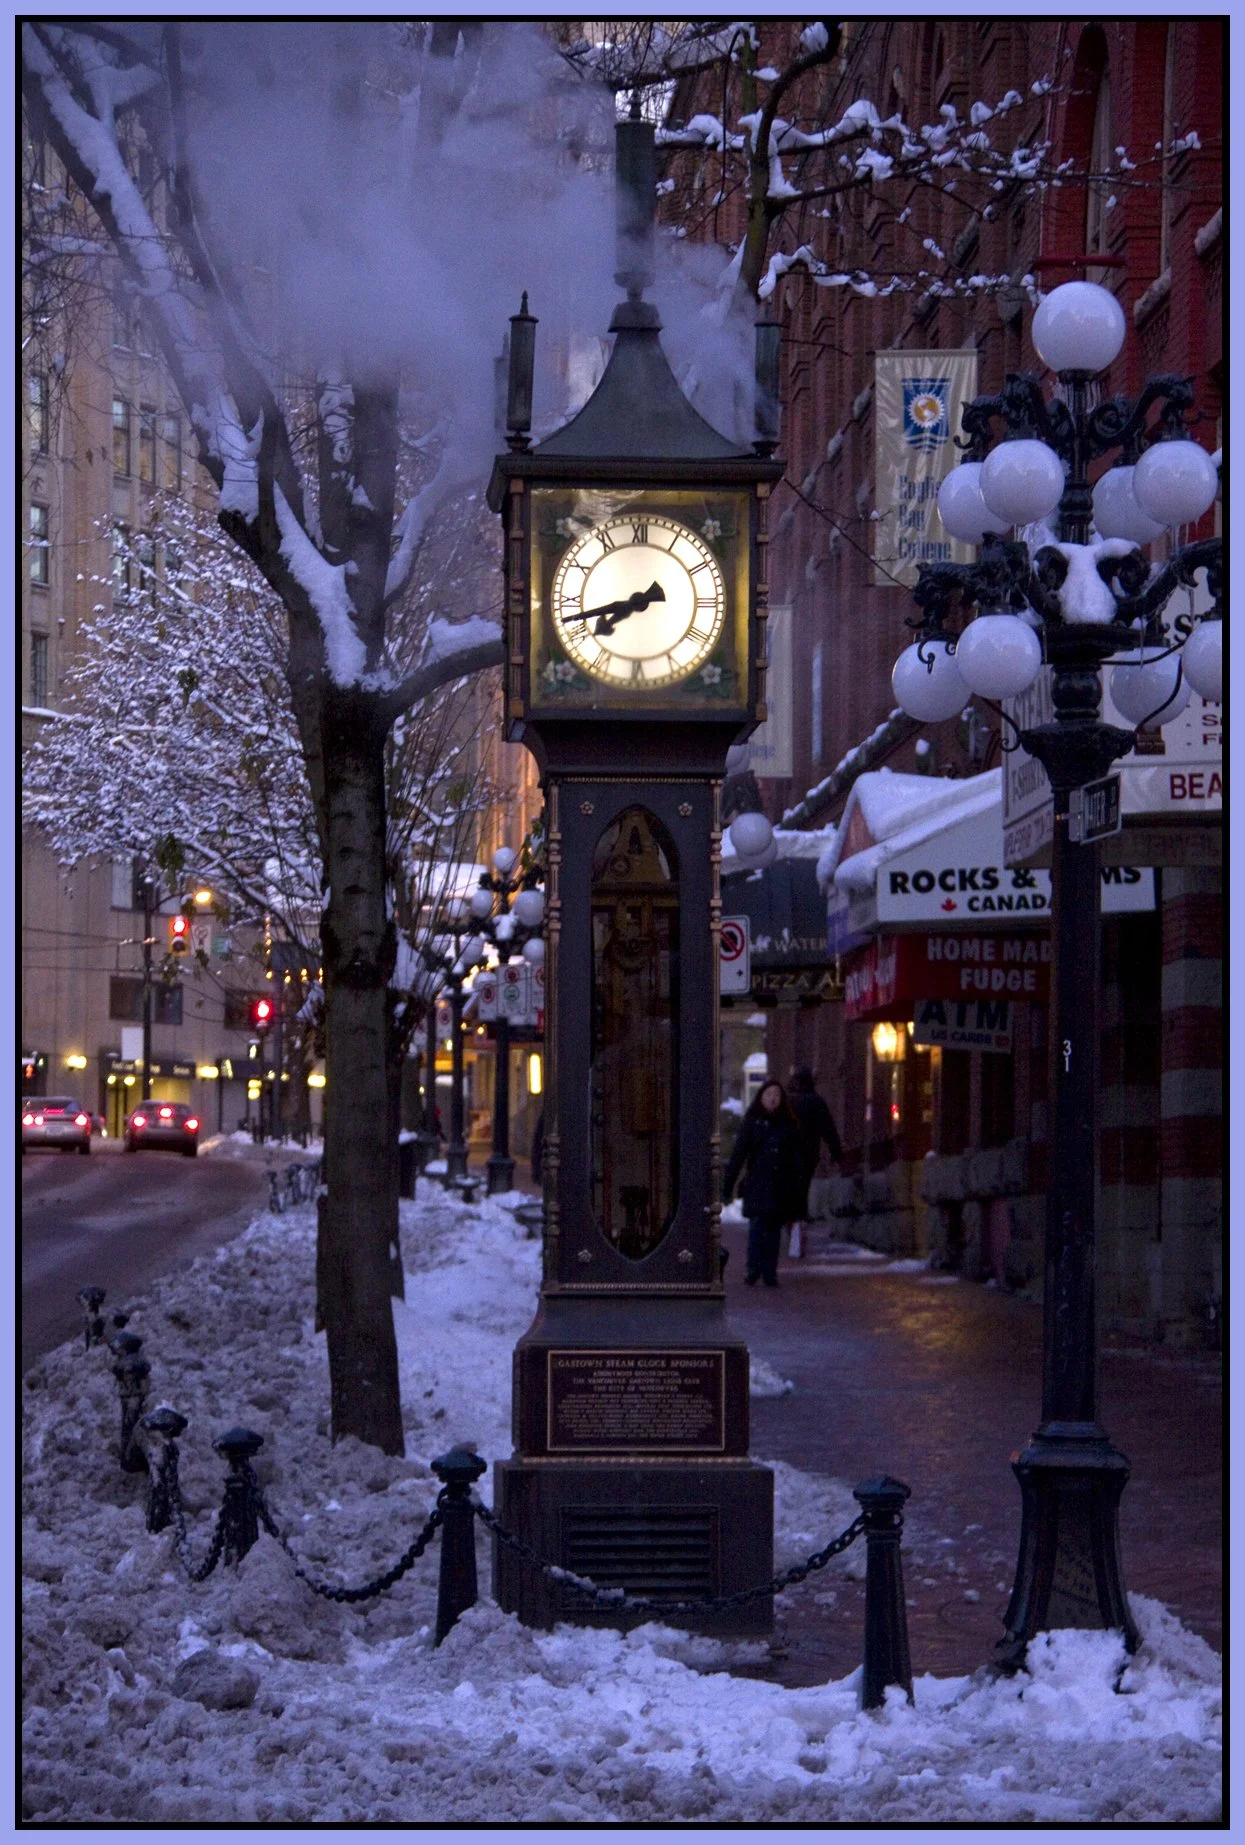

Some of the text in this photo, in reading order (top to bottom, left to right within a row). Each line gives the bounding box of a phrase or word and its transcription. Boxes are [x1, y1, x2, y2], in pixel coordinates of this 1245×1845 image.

[899, 475, 943, 503] Englis
[899, 505, 925, 529] Bay
[631, 523, 649, 544] XII
[898, 536, 952, 561] College
[889, 867, 1000, 894] ROCKS
[1012, 868, 1037, 888] &
[967, 894, 1052, 911] CANAD
[927, 937, 1051, 962] HOME MAD
[752, 973, 810, 991] PIZZA
[960, 967, 1037, 992] FUDGE
[921, 1000, 1007, 1031] ATM
[558, 1359, 715, 1368] GASTOWN STEAM CLOCK SPONSORS
